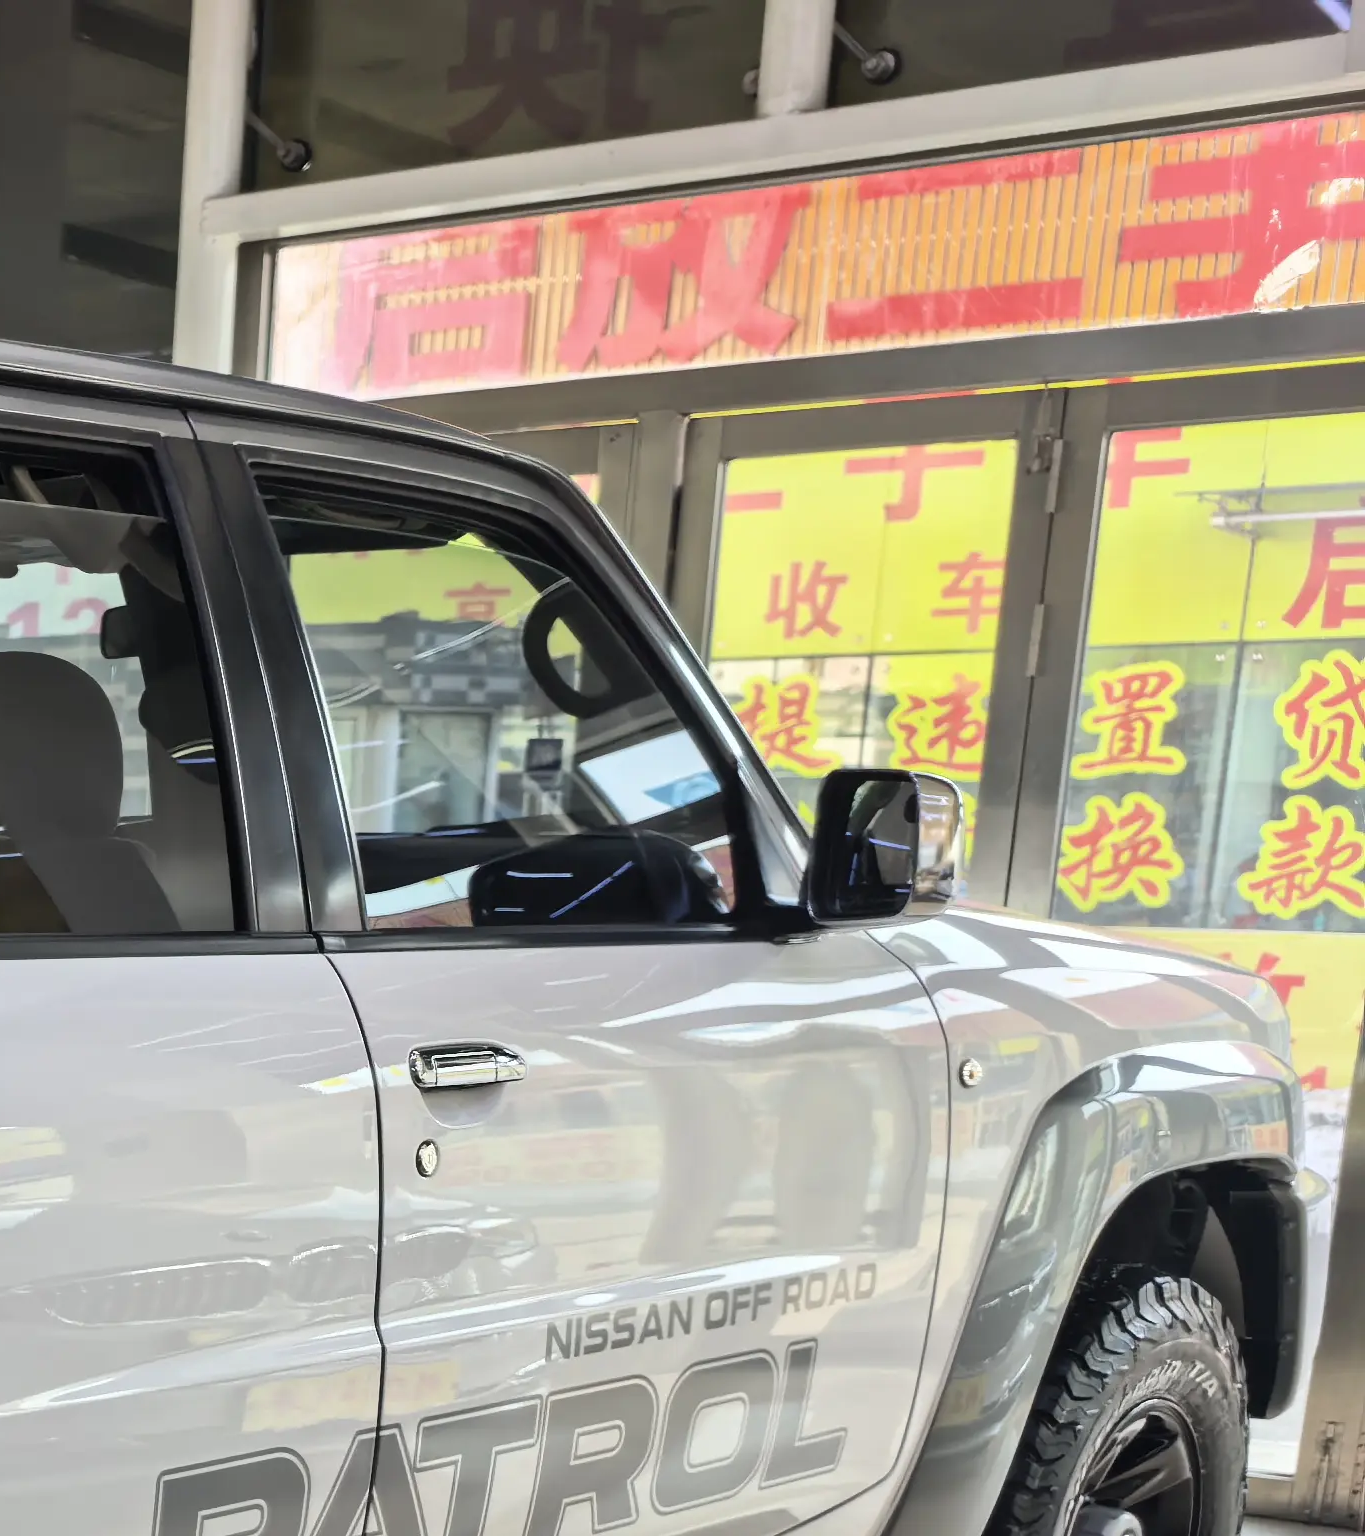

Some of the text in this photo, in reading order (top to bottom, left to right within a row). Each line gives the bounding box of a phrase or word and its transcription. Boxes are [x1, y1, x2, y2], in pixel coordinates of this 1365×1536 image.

[1058, 667, 1175, 904] 置换
[1246, 657, 1365, 909] 贷款
[545, 1263, 877, 1362] NISSAN OFF ROAD
